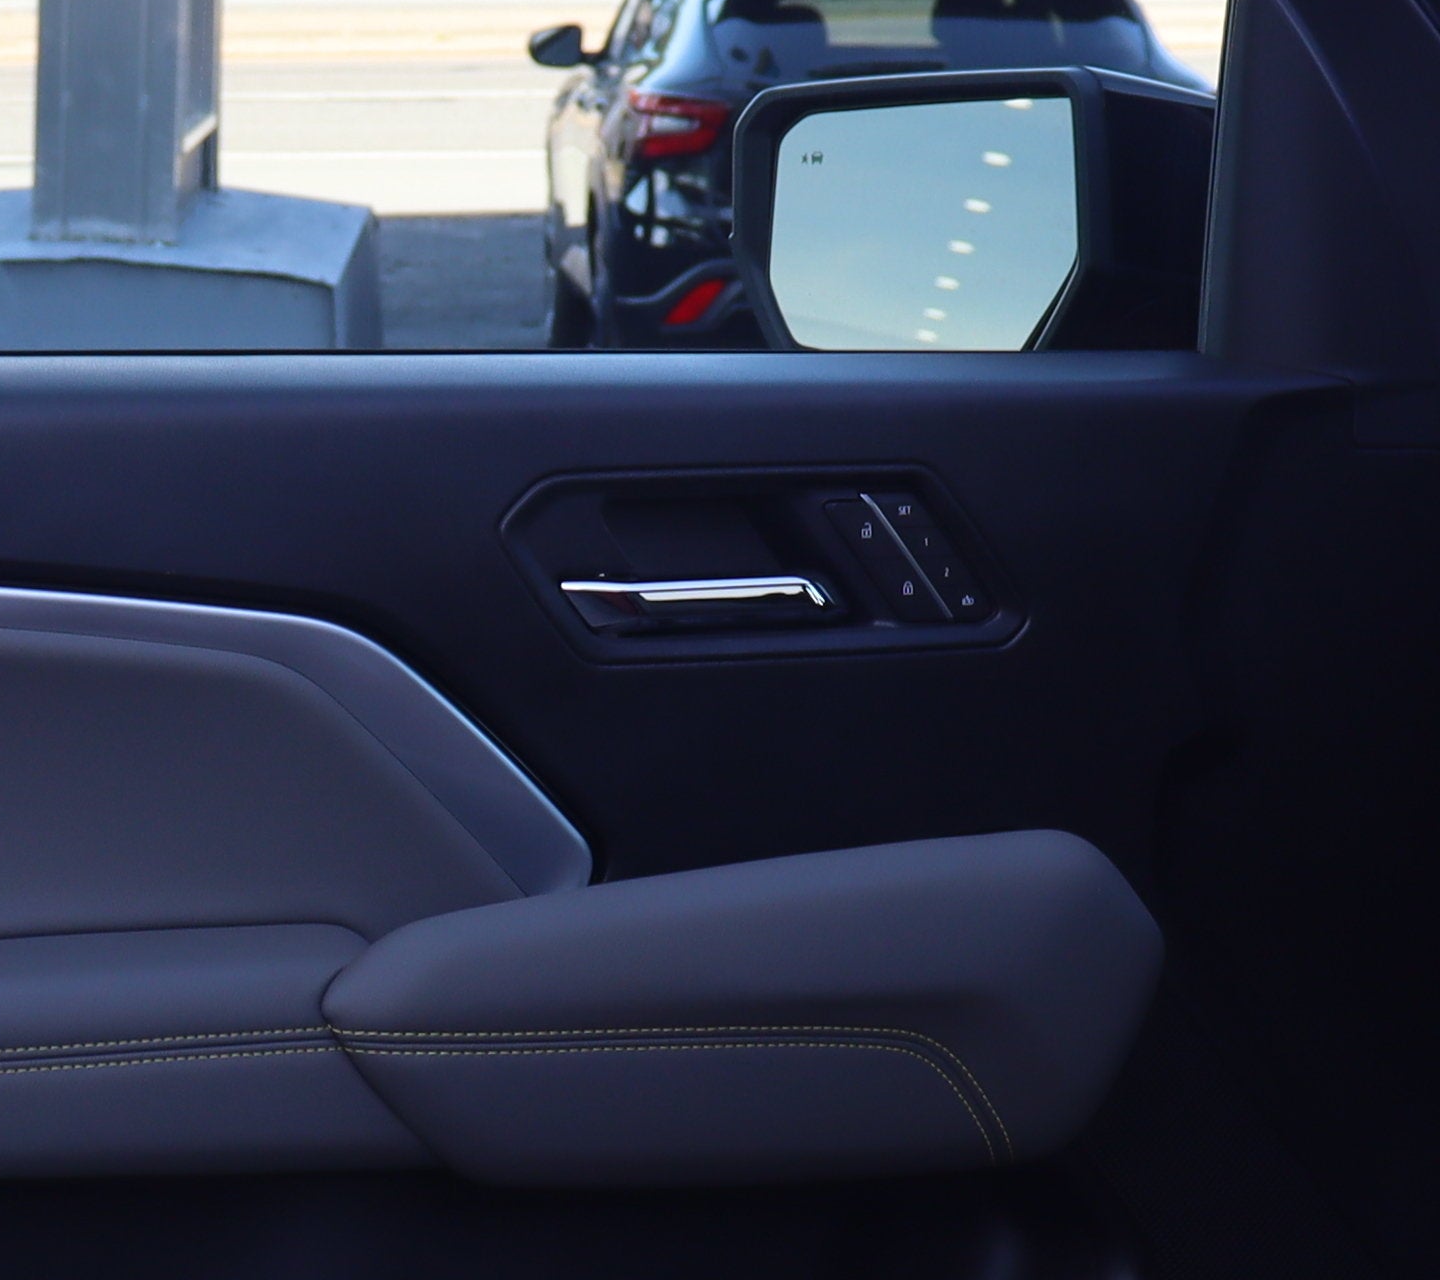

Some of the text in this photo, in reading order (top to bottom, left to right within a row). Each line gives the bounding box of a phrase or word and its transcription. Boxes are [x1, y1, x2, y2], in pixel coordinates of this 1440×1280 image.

[898, 505, 911, 516] SET
[924, 537, 929, 546] 1
[943, 567, 950, 577] 2
